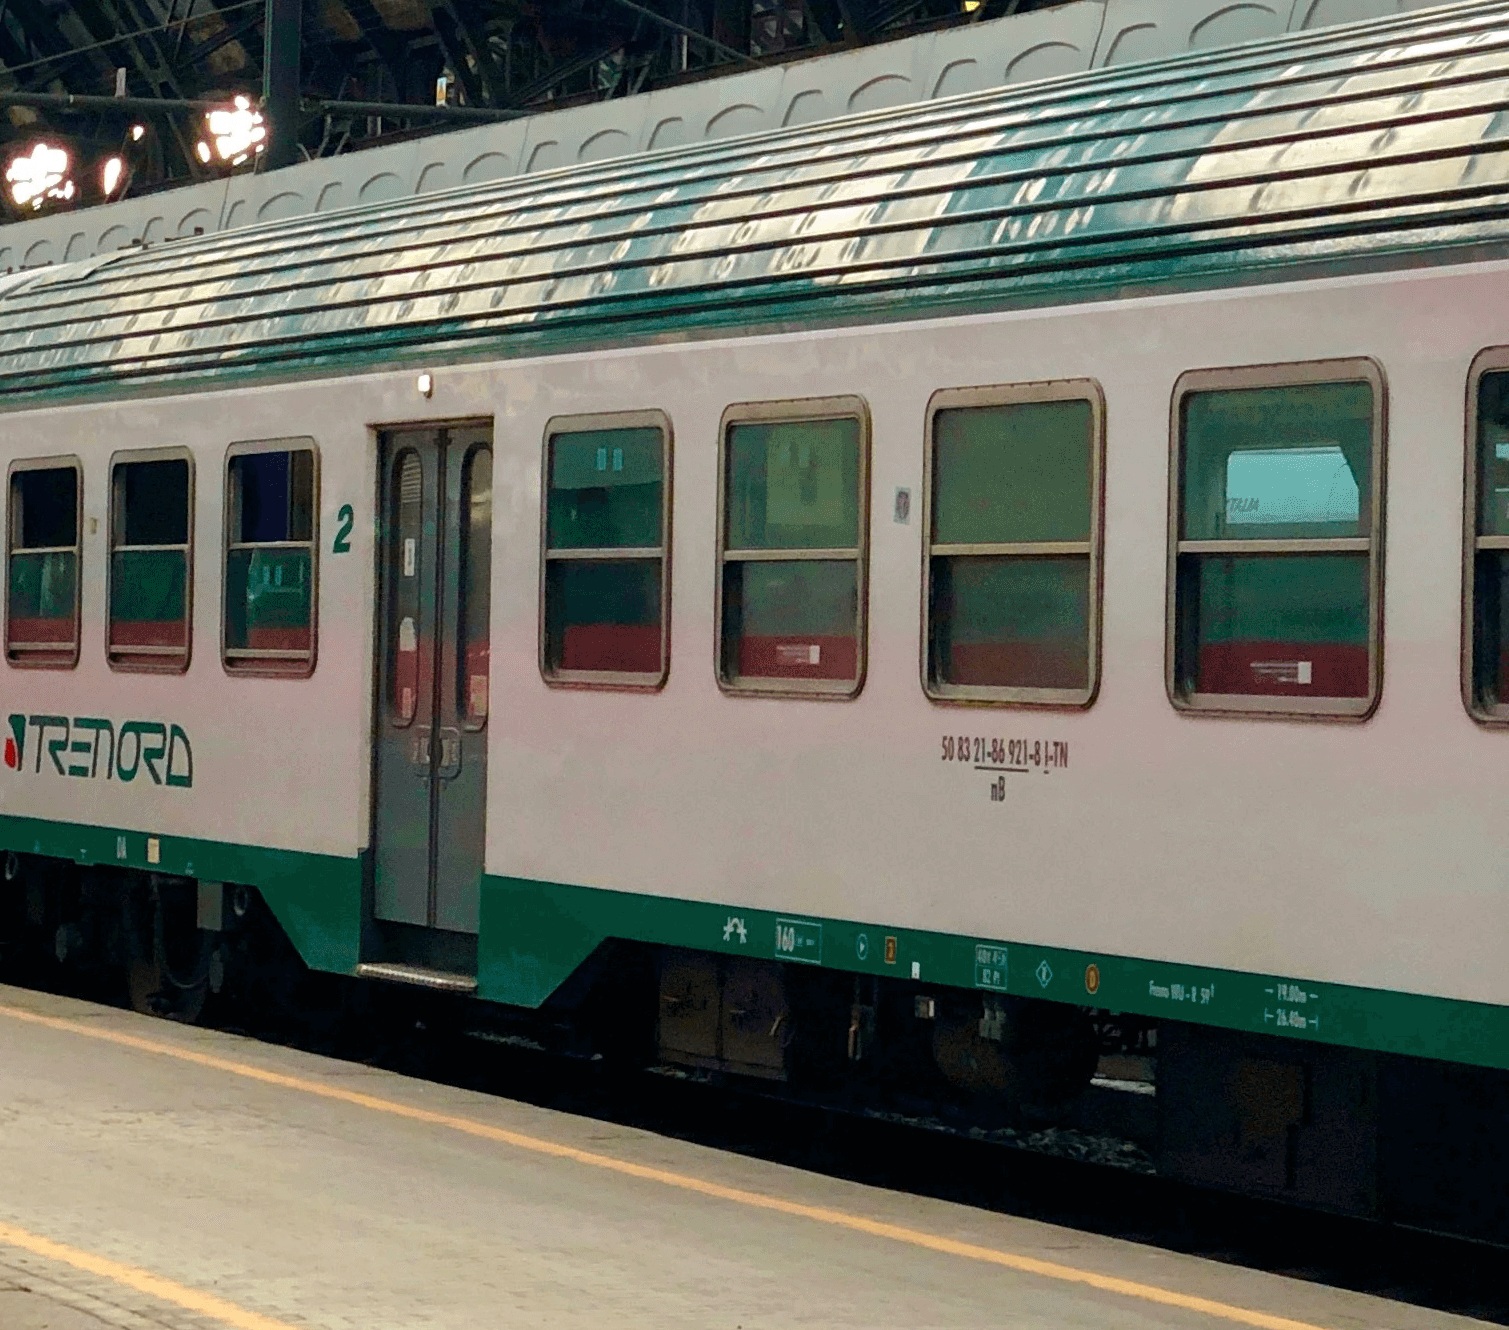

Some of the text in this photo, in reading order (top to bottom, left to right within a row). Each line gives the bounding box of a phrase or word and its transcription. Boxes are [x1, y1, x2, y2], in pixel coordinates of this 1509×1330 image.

[333, 503, 354, 554] 2
[29, 714, 193, 788] TRENORD
[941, 736, 954, 761] 50
[957, 736, 971, 762] 83
[974, 737, 1005, 763] 21-86
[1008, 739, 1040, 766] 921-8
[776, 925, 795, 952] 160
